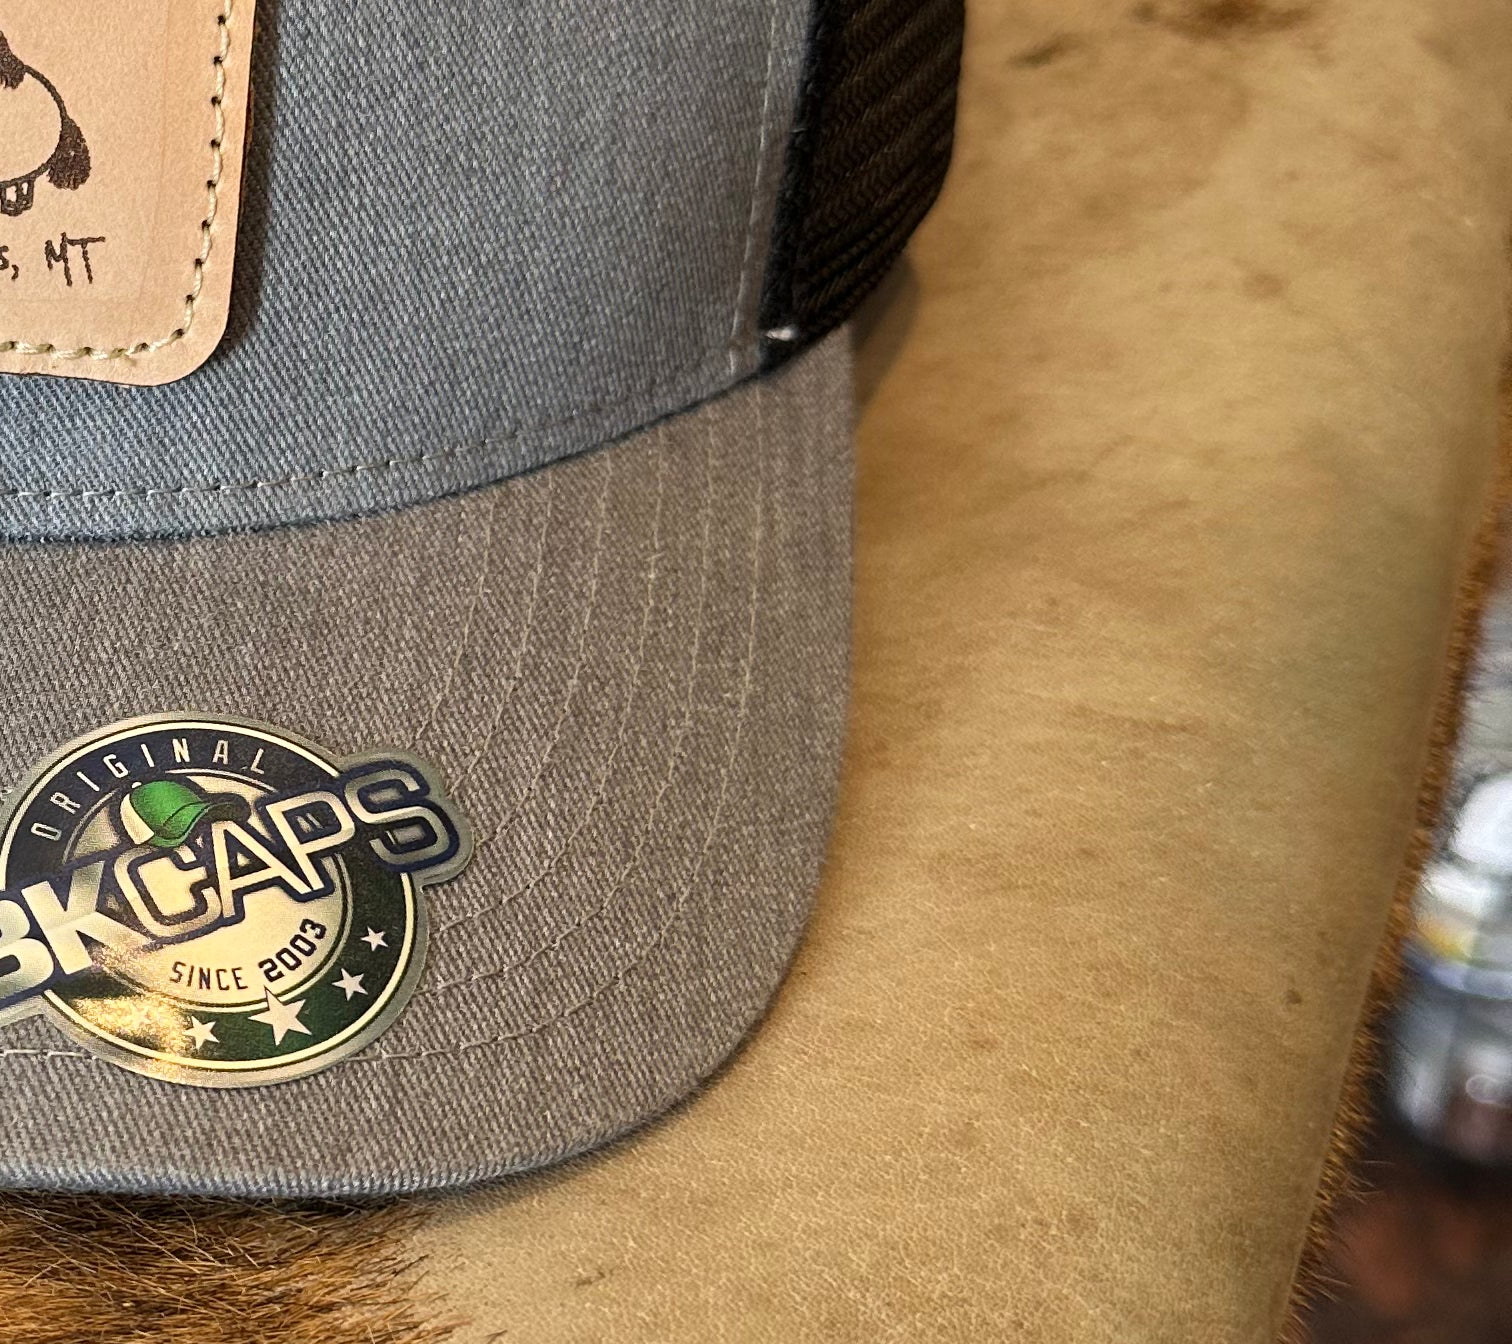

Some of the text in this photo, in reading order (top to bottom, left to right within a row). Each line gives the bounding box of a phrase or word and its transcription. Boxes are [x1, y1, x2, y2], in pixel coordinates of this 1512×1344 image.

[44, 232, 106, 287] MT
[30, 737, 267, 842] ORIGINAL
[169, 917, 328, 991] SINCE 2003
